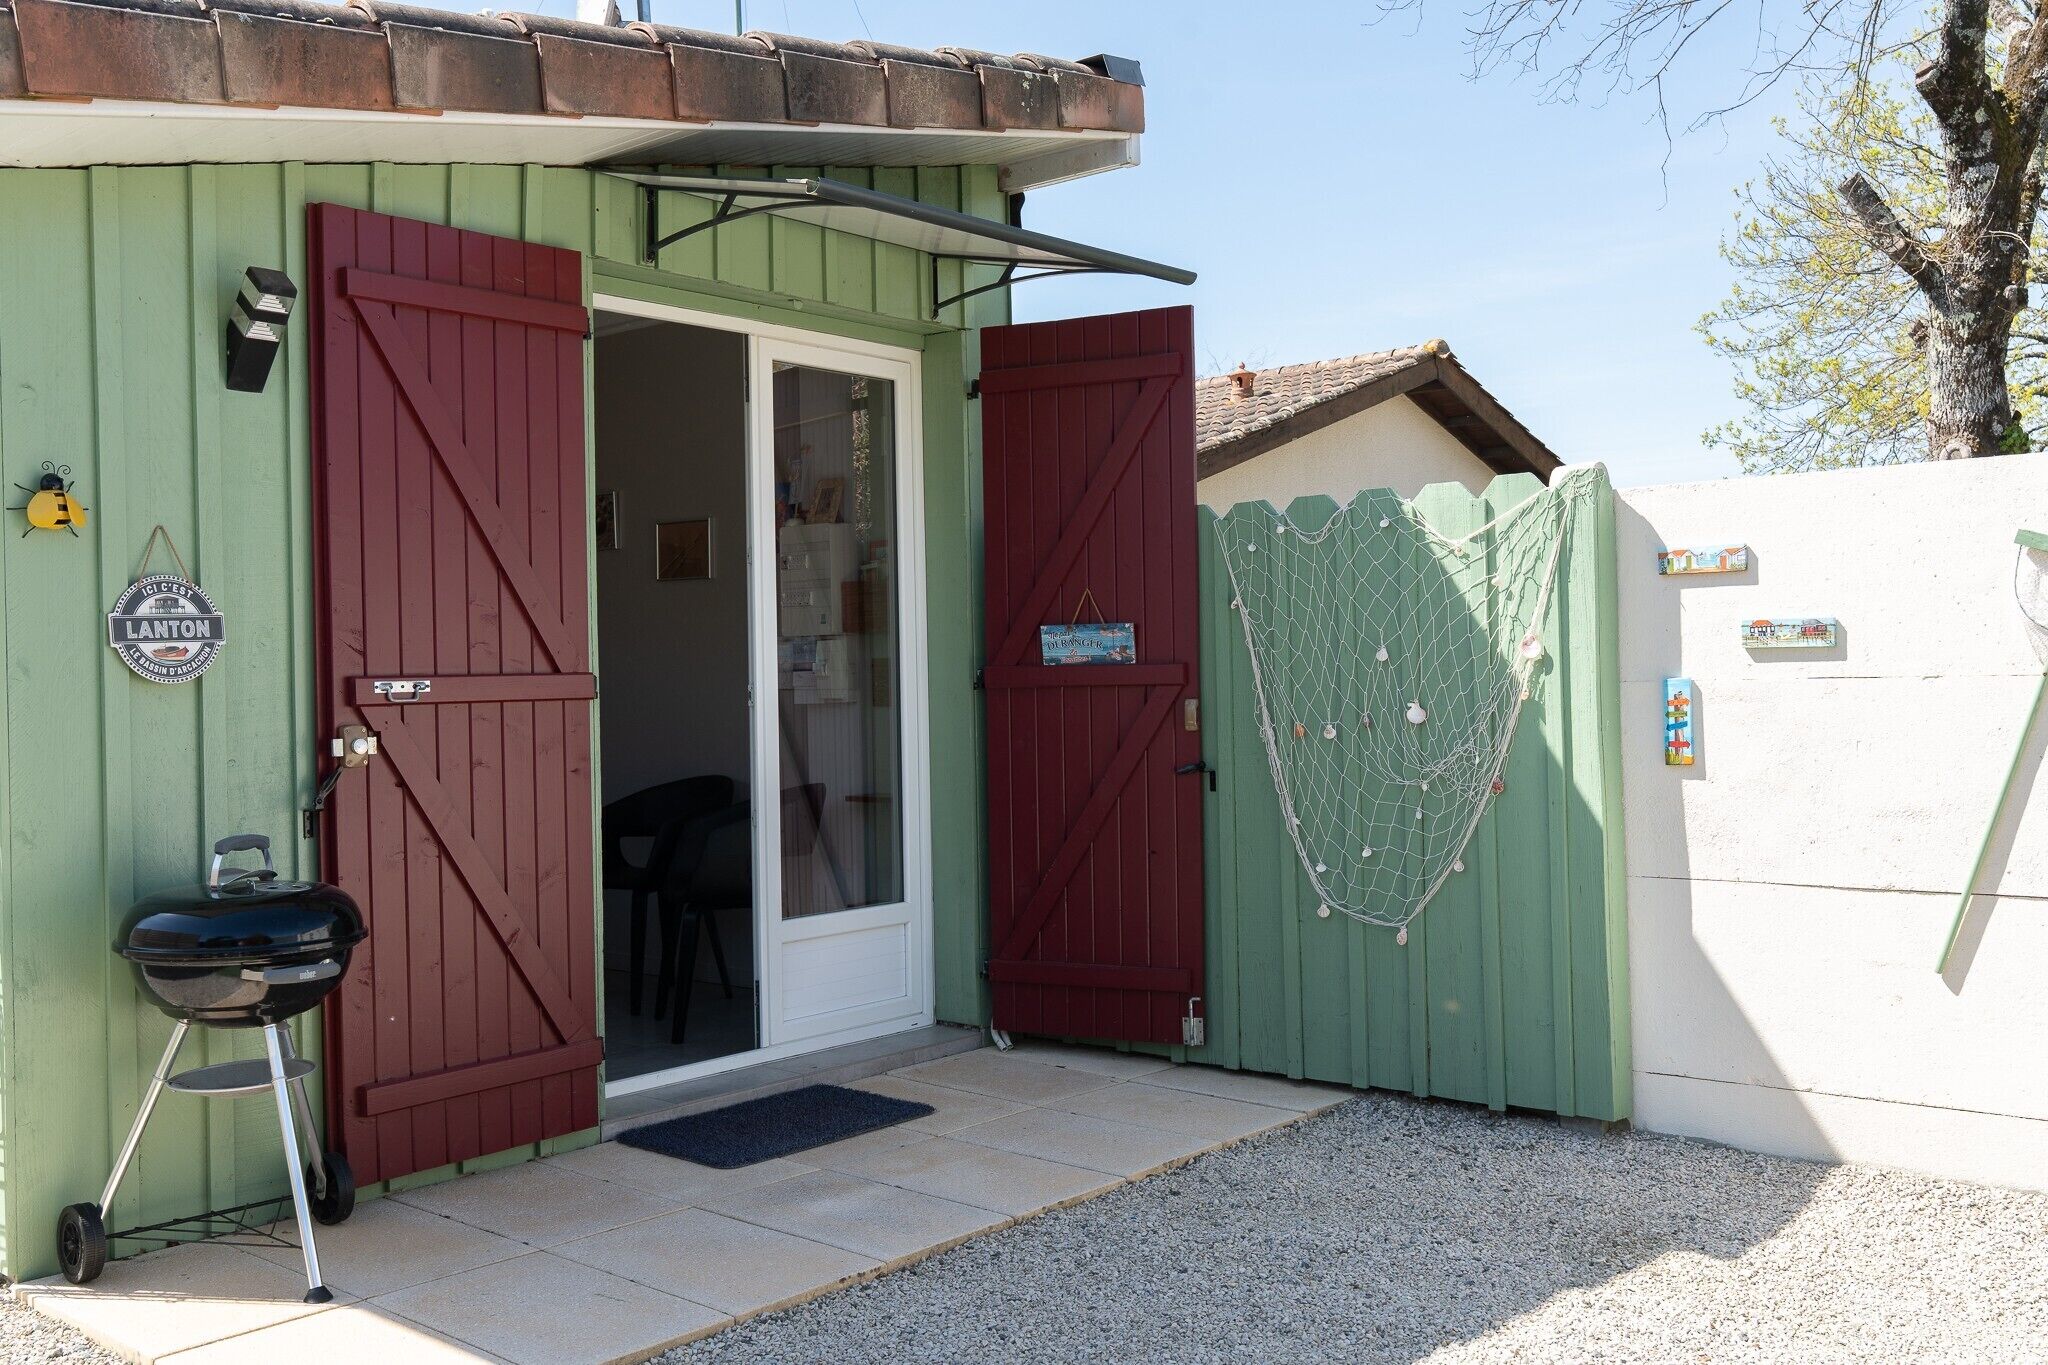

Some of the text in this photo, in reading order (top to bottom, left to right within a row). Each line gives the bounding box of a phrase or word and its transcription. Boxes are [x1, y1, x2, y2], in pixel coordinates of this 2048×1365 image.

[141, 582, 194, 598] ICI C'EST
[126, 620, 210, 639] LANTON
[129, 646, 211, 675] LE BASSIN D'ARCACHON
